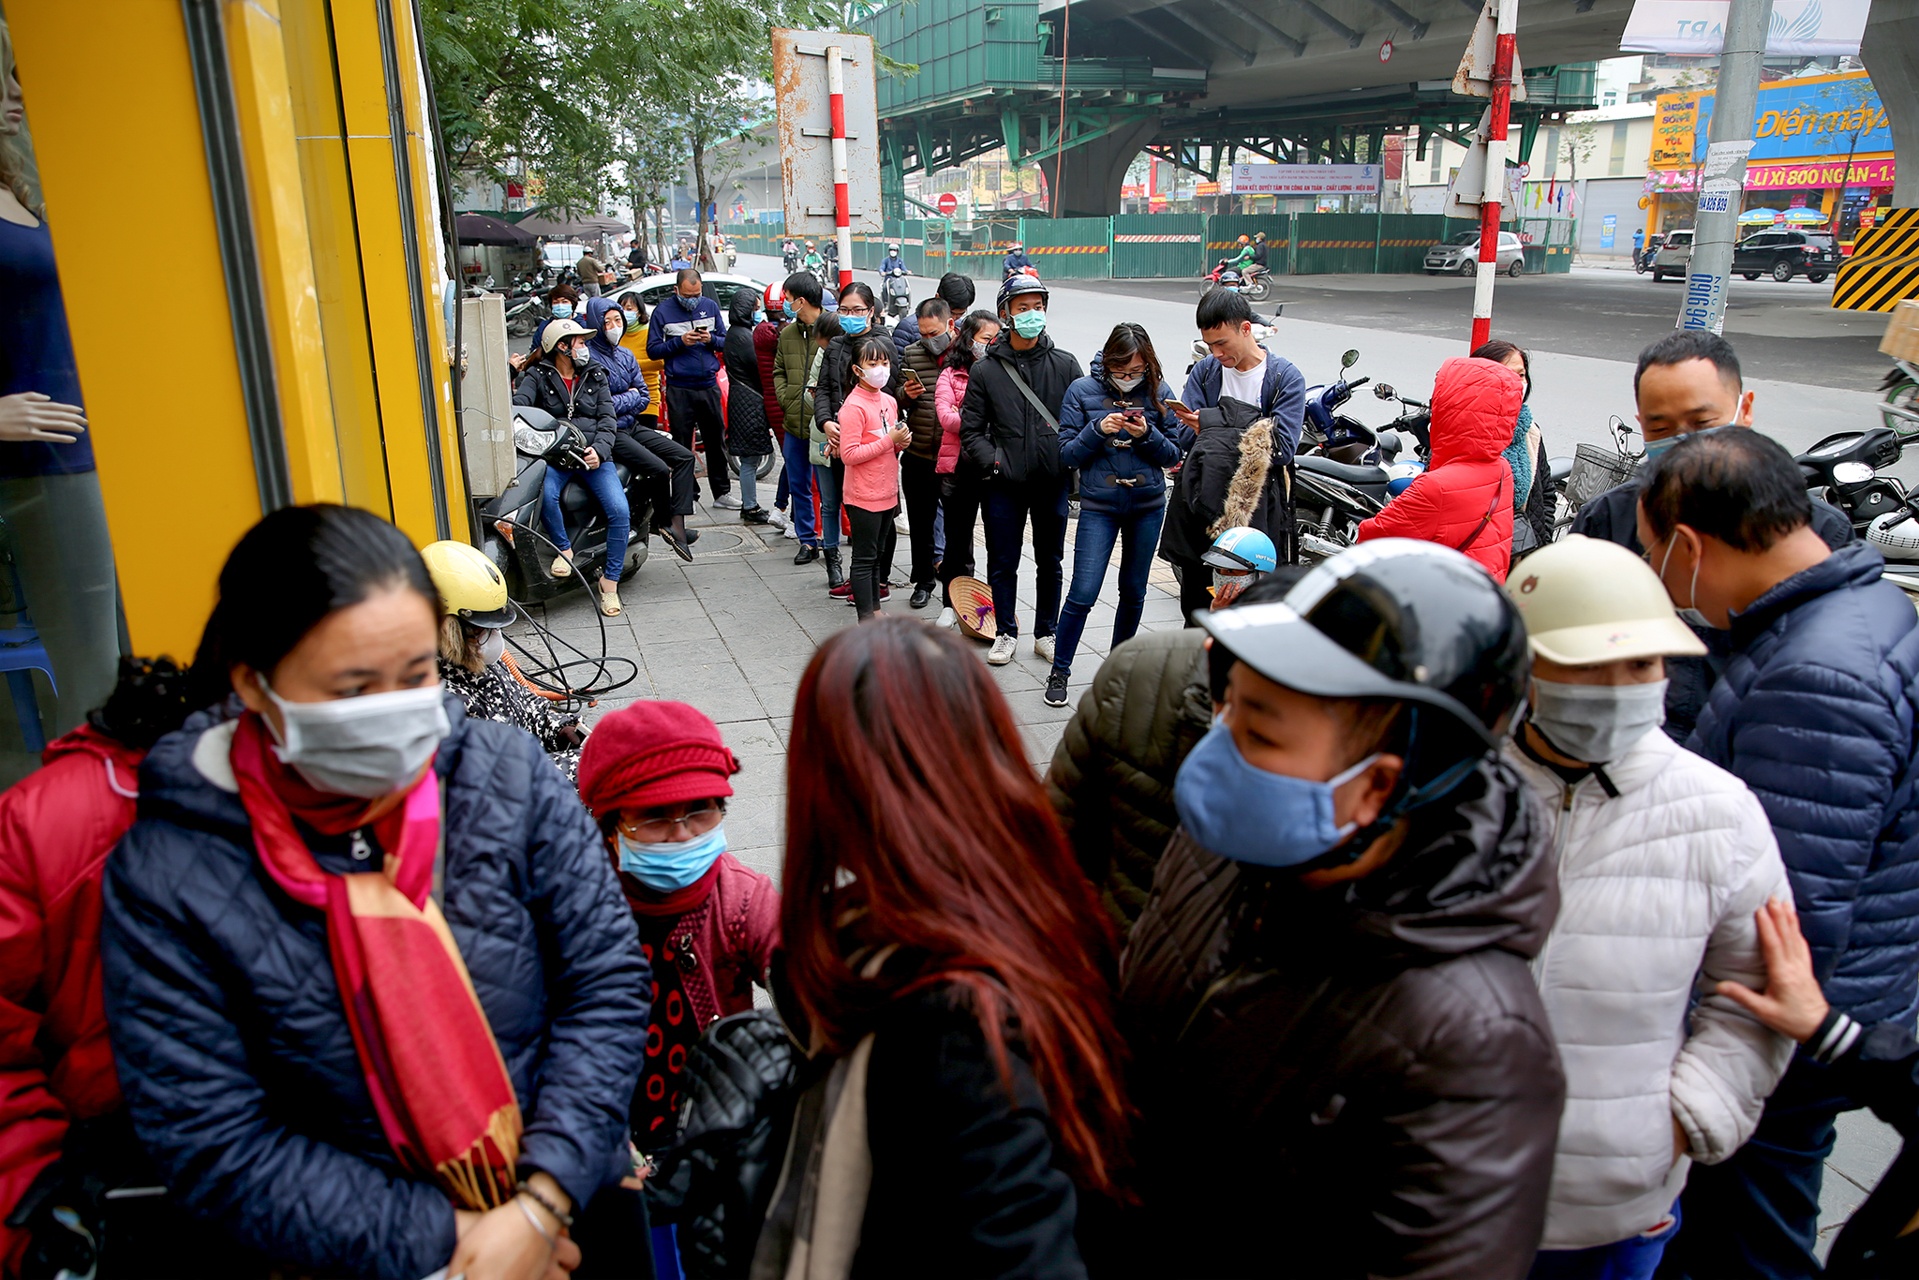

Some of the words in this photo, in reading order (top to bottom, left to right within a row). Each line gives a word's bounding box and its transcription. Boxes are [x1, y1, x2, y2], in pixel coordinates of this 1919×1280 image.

[1755, 107, 1817, 142] Điện
[1754, 167, 1770, 187] LÌ
[1770, 167, 1785, 186] XÌ
[1786, 169, 1819, 186] 800
[1821, 164, 1870, 185] NGÀN
[1687, 273, 1713, 306] 0916
